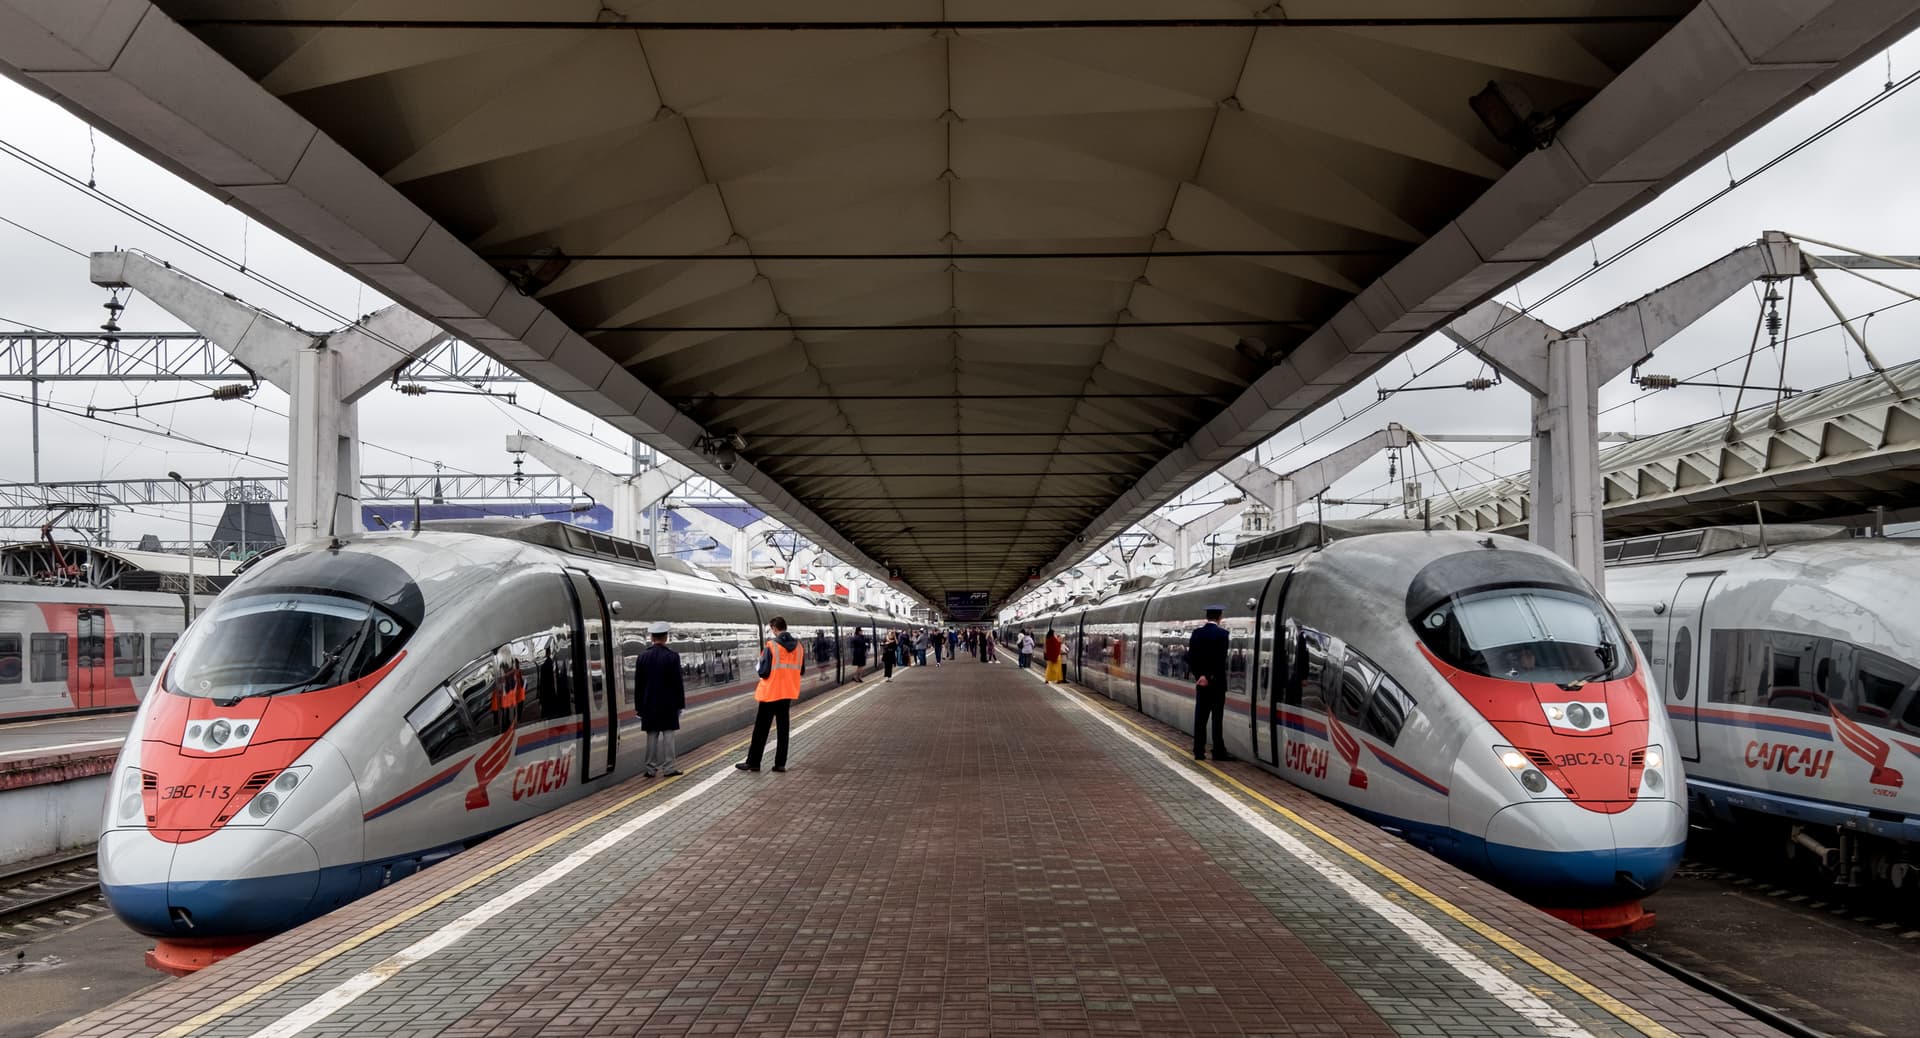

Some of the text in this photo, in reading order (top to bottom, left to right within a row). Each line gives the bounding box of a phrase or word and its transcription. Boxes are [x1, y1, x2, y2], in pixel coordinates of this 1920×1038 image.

[512, 754, 571, 801] САПСАН
[1285, 740, 1329, 780] САПСАН
[1554, 752, 1628, 767] ЭВС2-02
[1745, 740, 1834, 779] САПСАН
